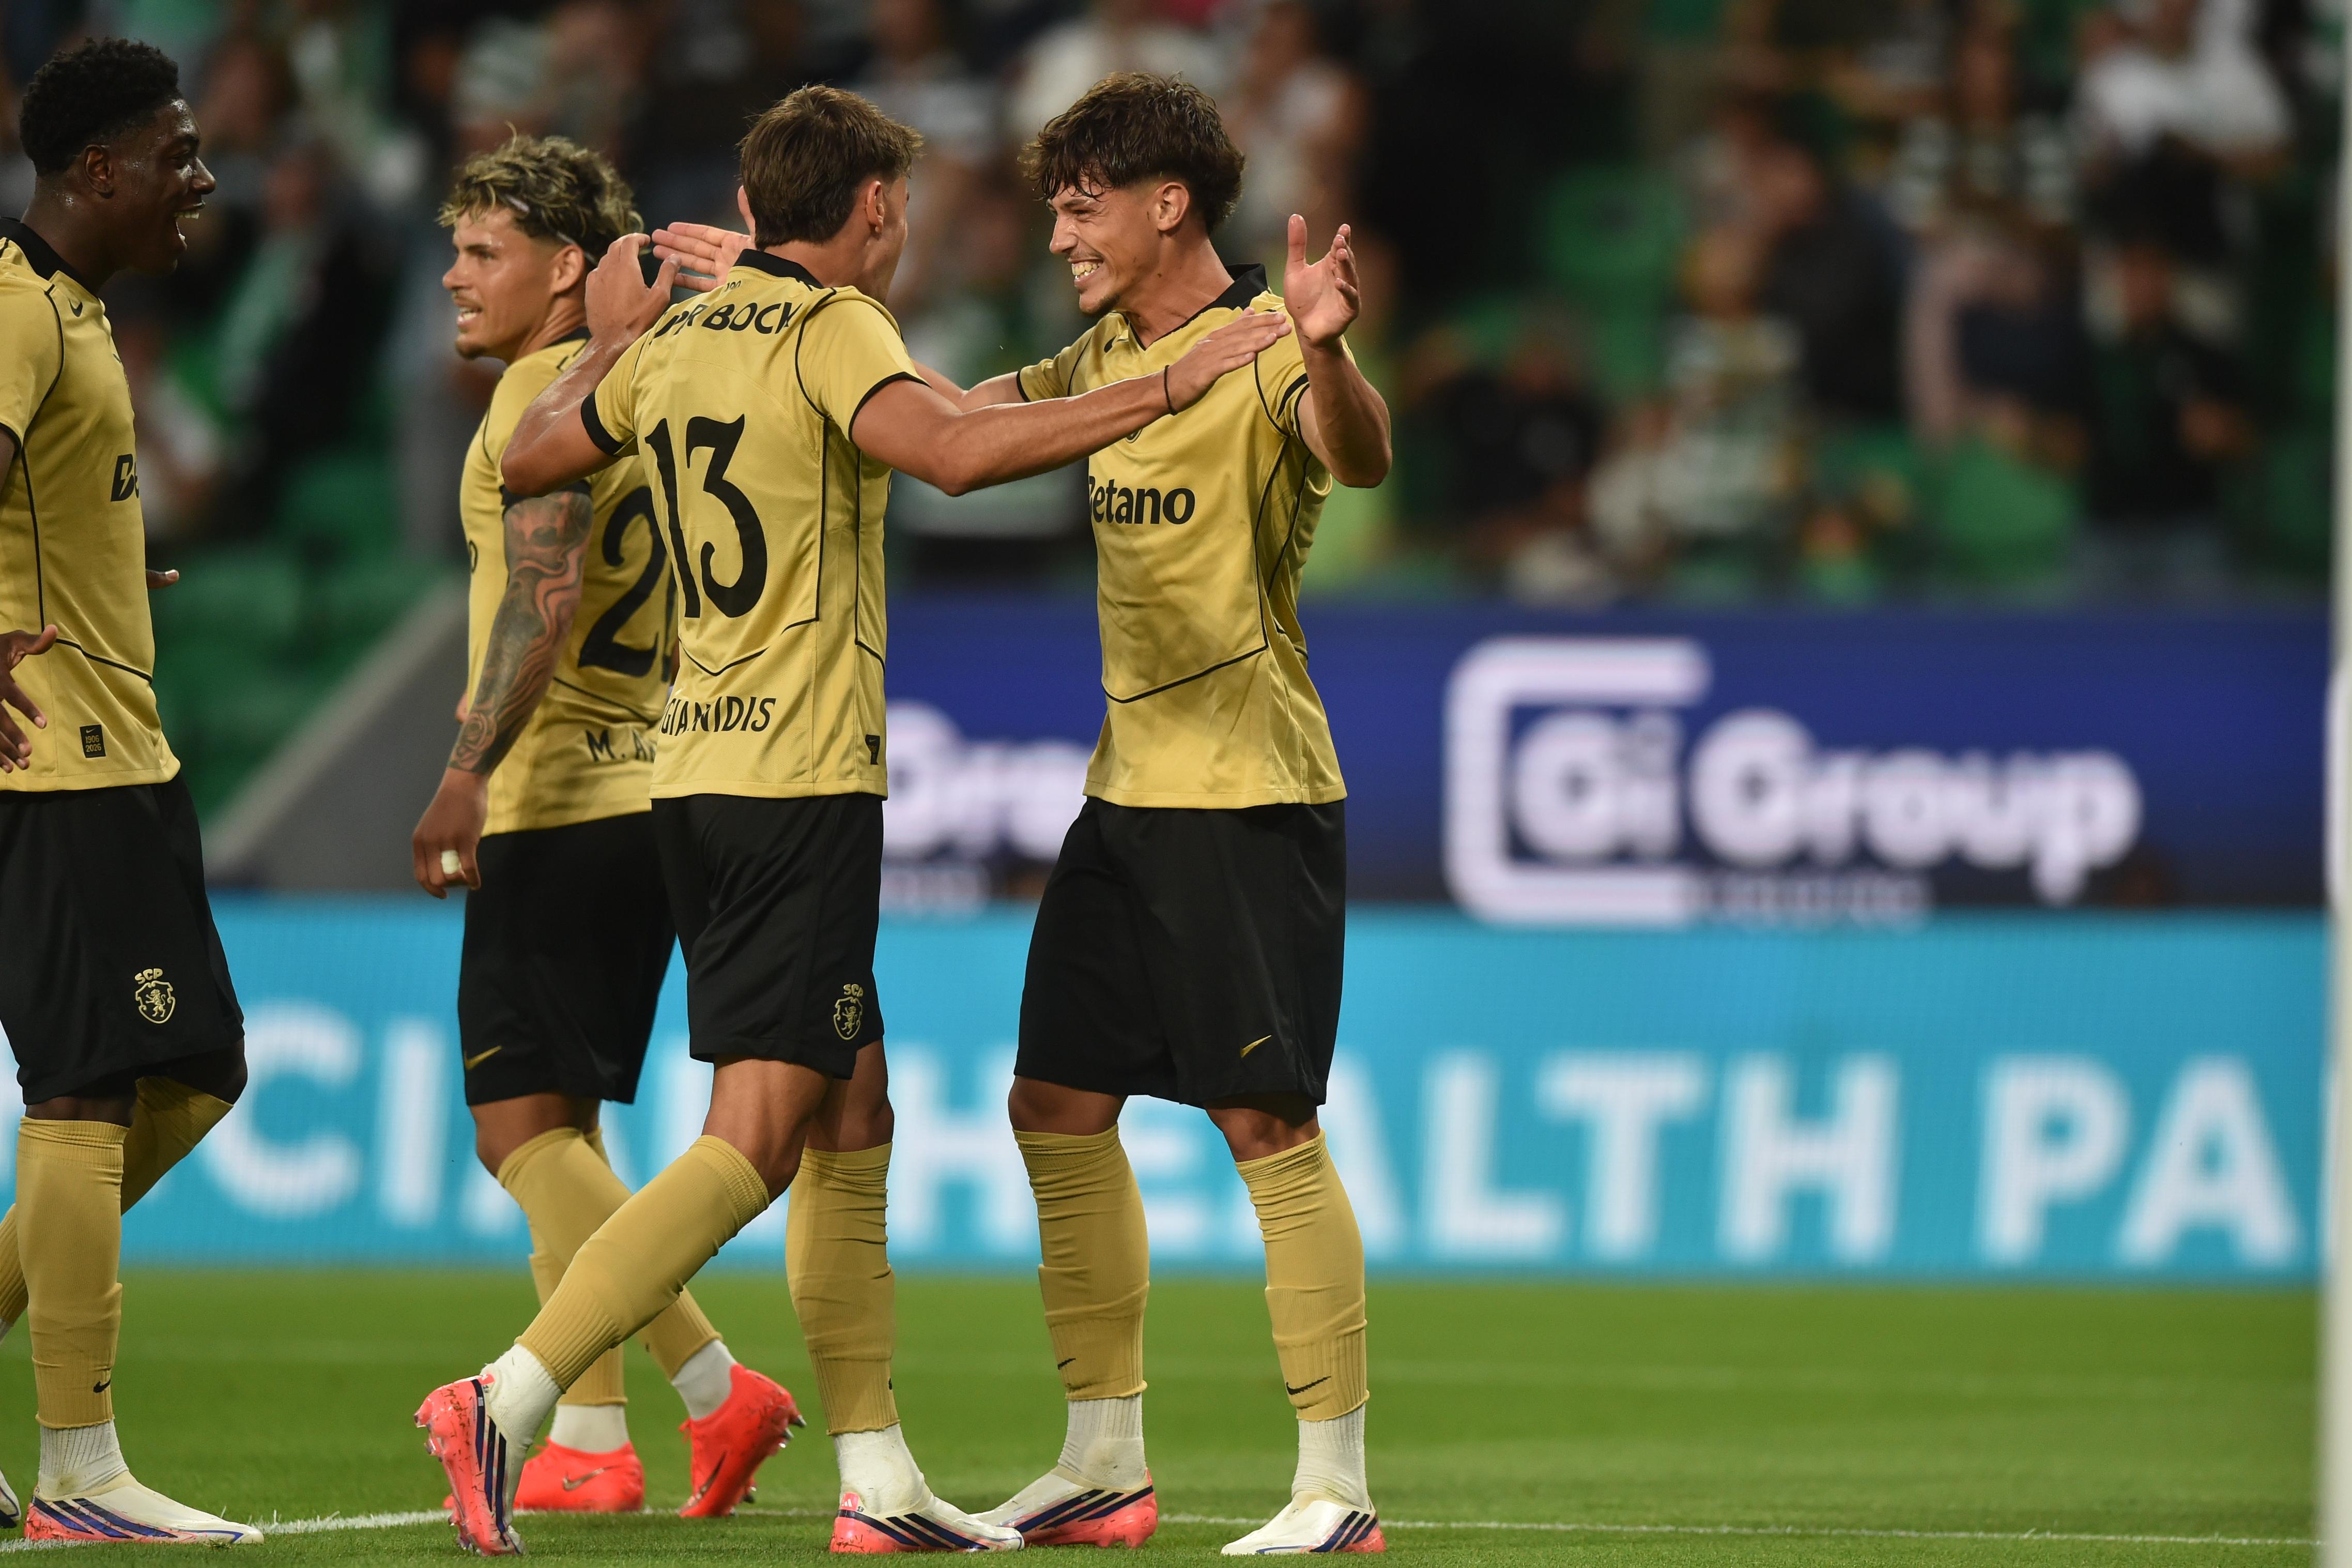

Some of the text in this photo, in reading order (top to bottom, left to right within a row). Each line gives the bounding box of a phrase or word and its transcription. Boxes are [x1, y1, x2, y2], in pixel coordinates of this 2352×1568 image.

[701, 302, 803, 334] BOCK
[111, 453, 139, 501] B
[644, 413, 767, 618] 13
[577, 486, 678, 681] 2
[85, 735, 100, 744] 1906
[85, 743, 102, 752] 2026
[135, 968, 163, 985] SCP
[1979, 1052, 2320, 1265] PA
